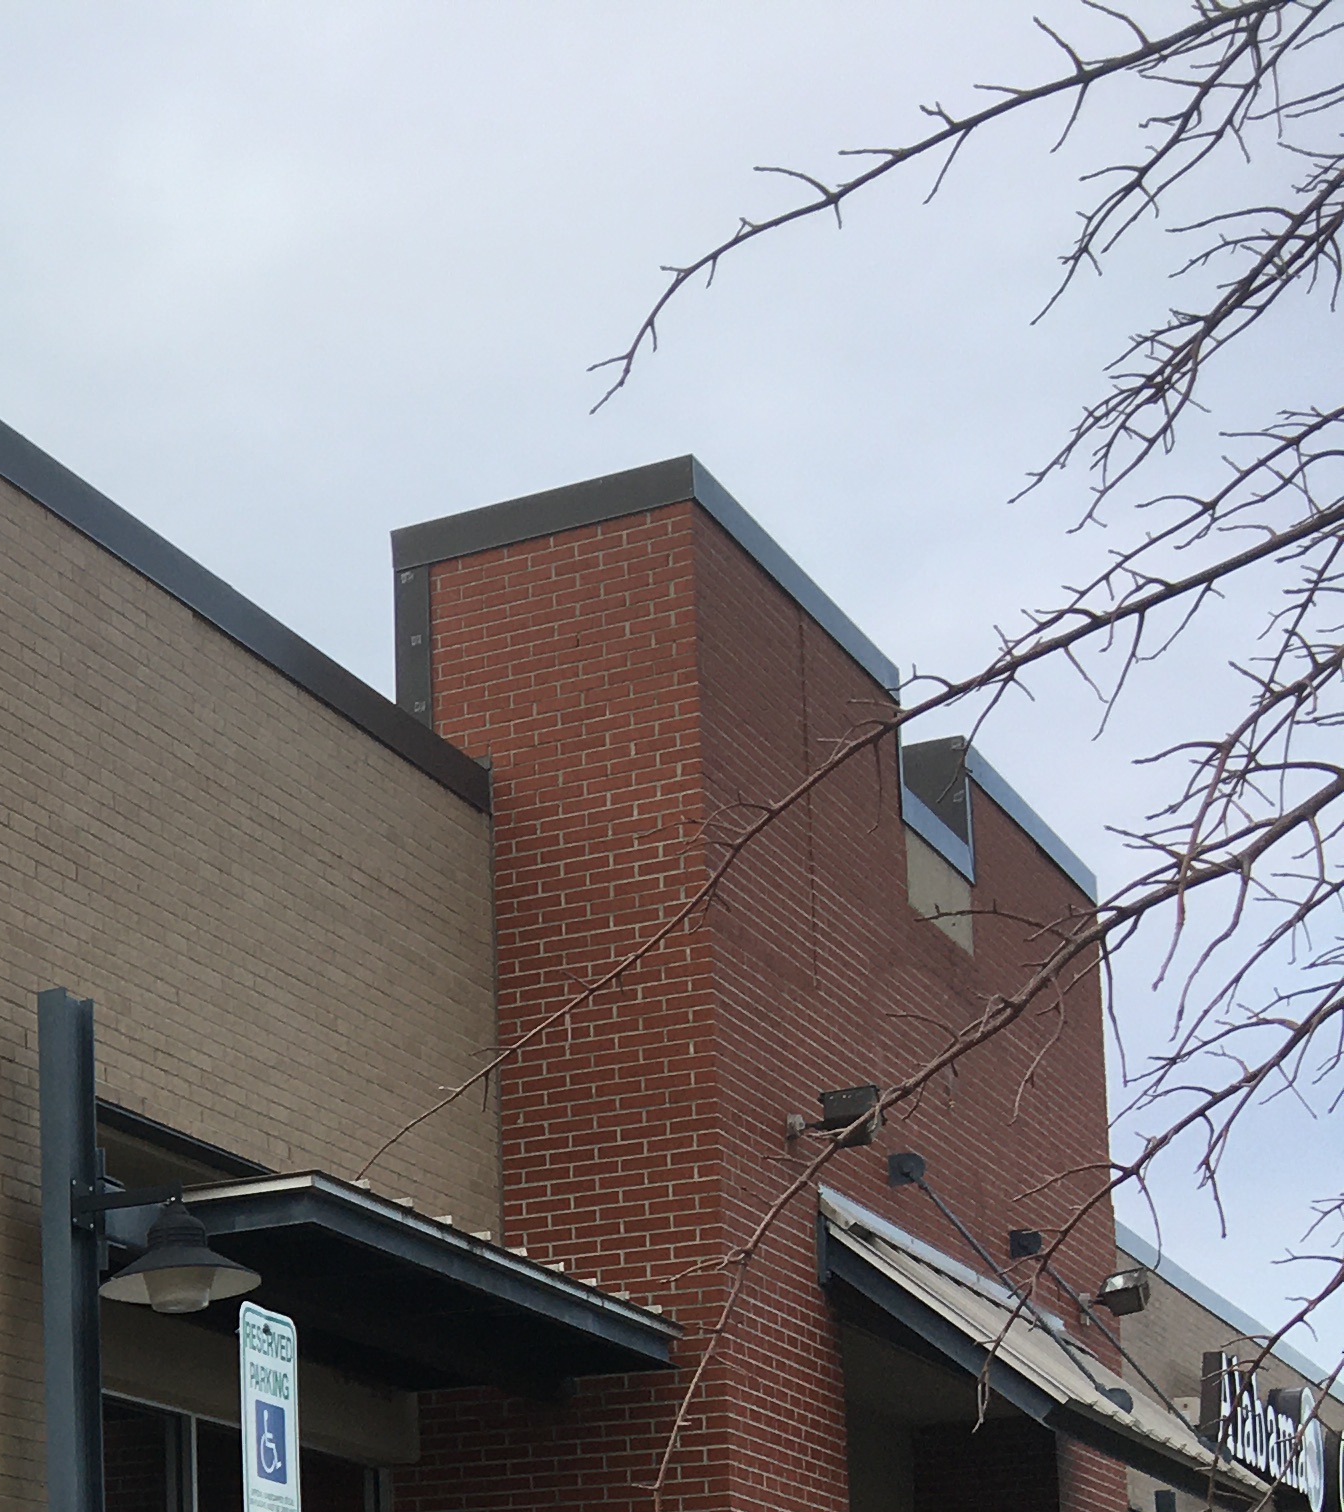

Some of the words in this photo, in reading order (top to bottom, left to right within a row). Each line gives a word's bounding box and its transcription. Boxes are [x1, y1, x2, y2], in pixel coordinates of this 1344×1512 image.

[244, 1320, 293, 1363] RESERVED
[249, 1361, 290, 1400] PARKING
[1217, 1352, 1308, 1494] Alabama
